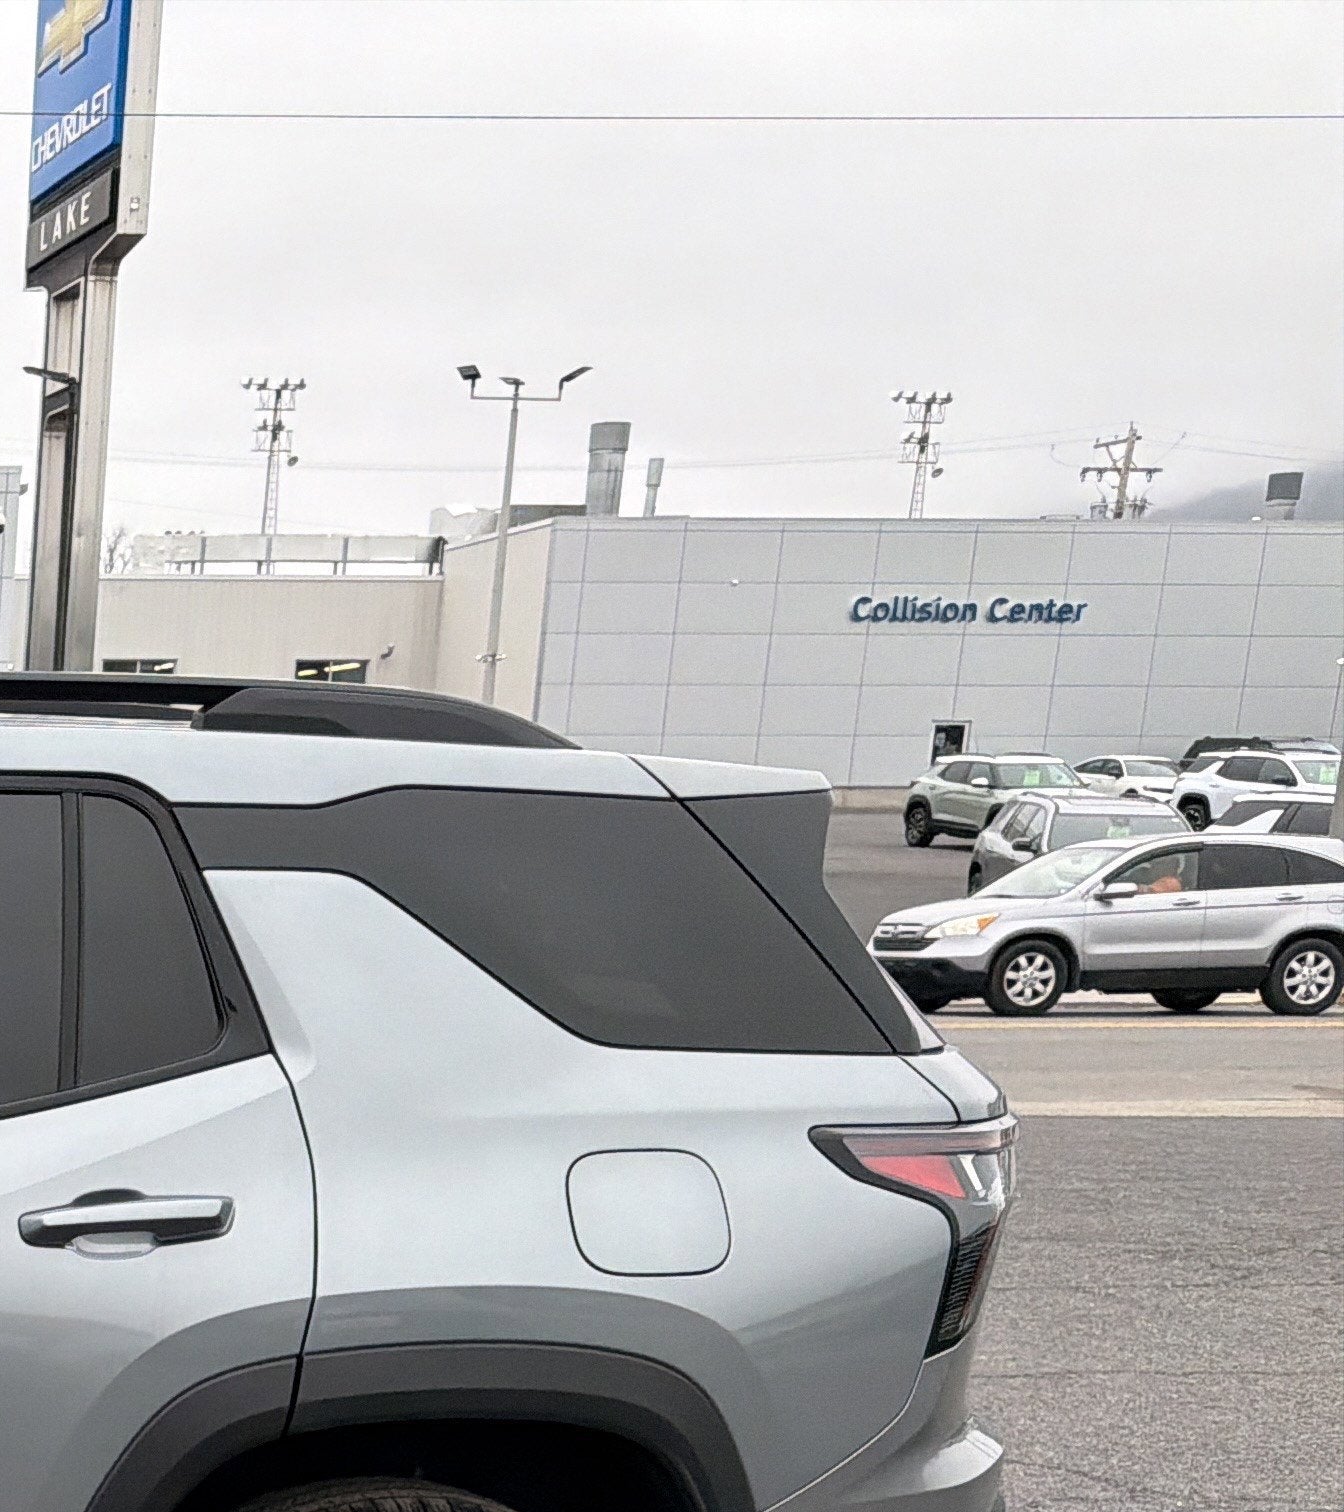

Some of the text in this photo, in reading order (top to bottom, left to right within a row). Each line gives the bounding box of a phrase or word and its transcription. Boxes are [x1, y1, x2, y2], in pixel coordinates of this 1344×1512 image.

[31, 83, 112, 173] CHEVROLET
[39, 192, 92, 252] LAKE
[850, 596, 1088, 623] Collision Center
